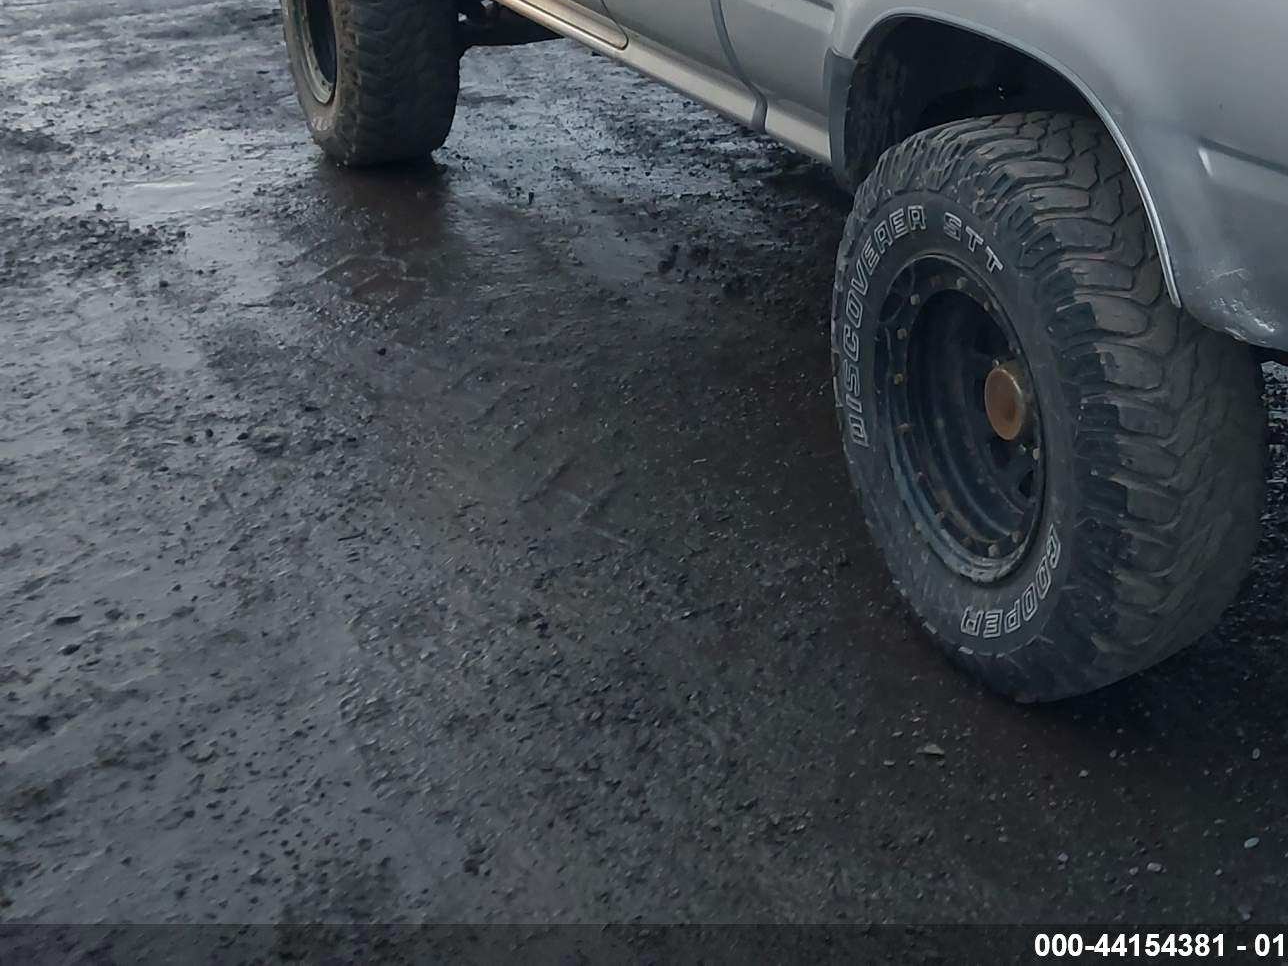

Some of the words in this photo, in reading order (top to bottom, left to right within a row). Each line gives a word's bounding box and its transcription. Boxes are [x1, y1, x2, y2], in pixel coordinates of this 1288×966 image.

[842, 204, 927, 448] DISCOVERER
[943, 211, 1004, 275] STT
[960, 523, 1061, 639] COOPER
